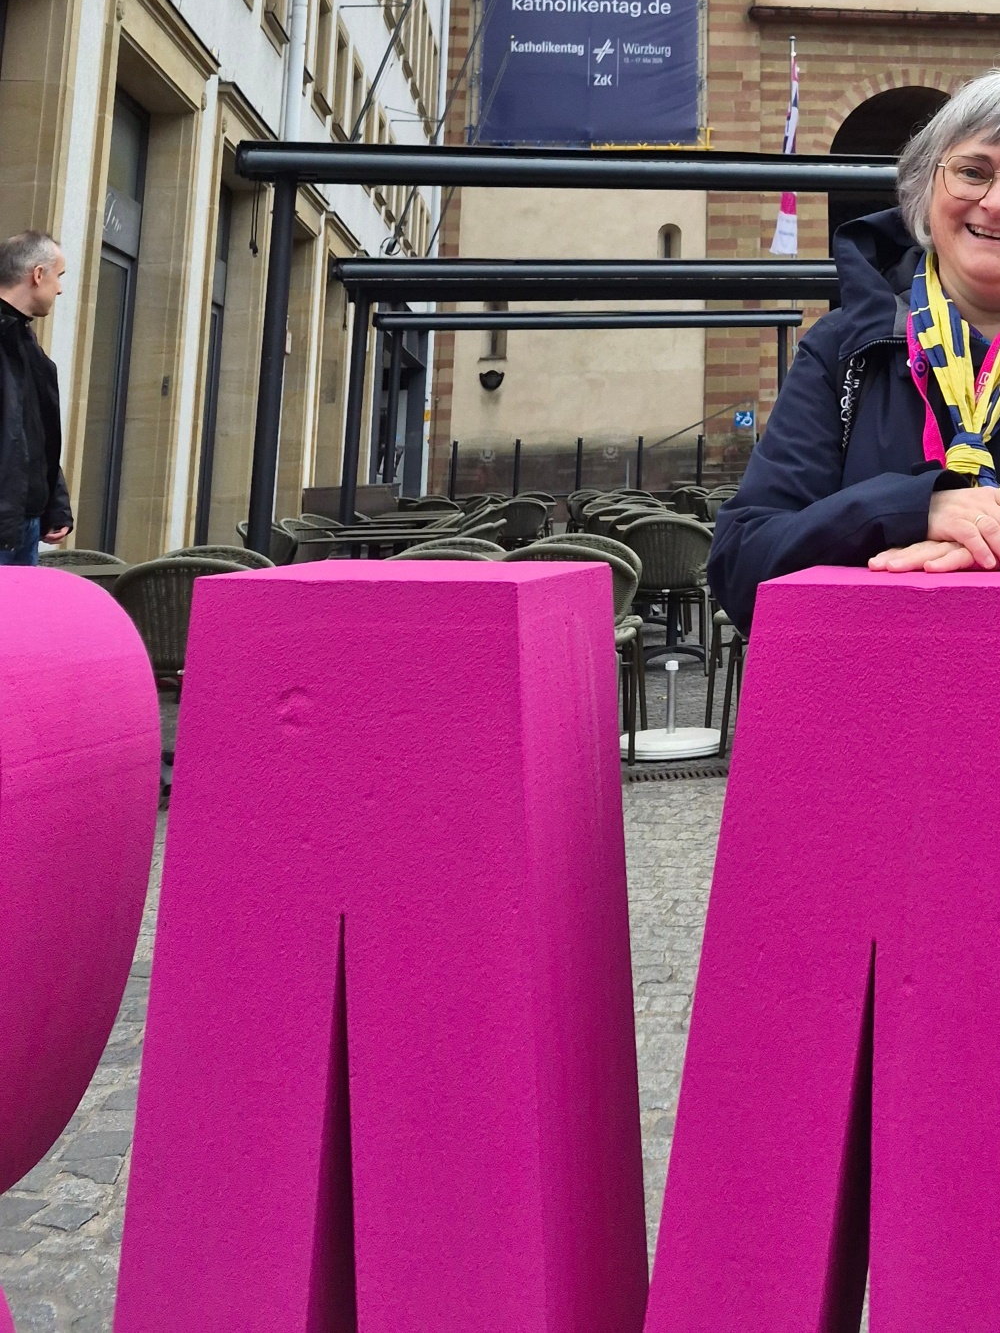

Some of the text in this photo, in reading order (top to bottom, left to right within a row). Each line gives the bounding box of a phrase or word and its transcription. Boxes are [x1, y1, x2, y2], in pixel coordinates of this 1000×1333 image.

[510, 40, 585, 56] Katholikentag
[622, 42, 672, 58] Würzburg
[593, 73, 613, 86] ZdK
